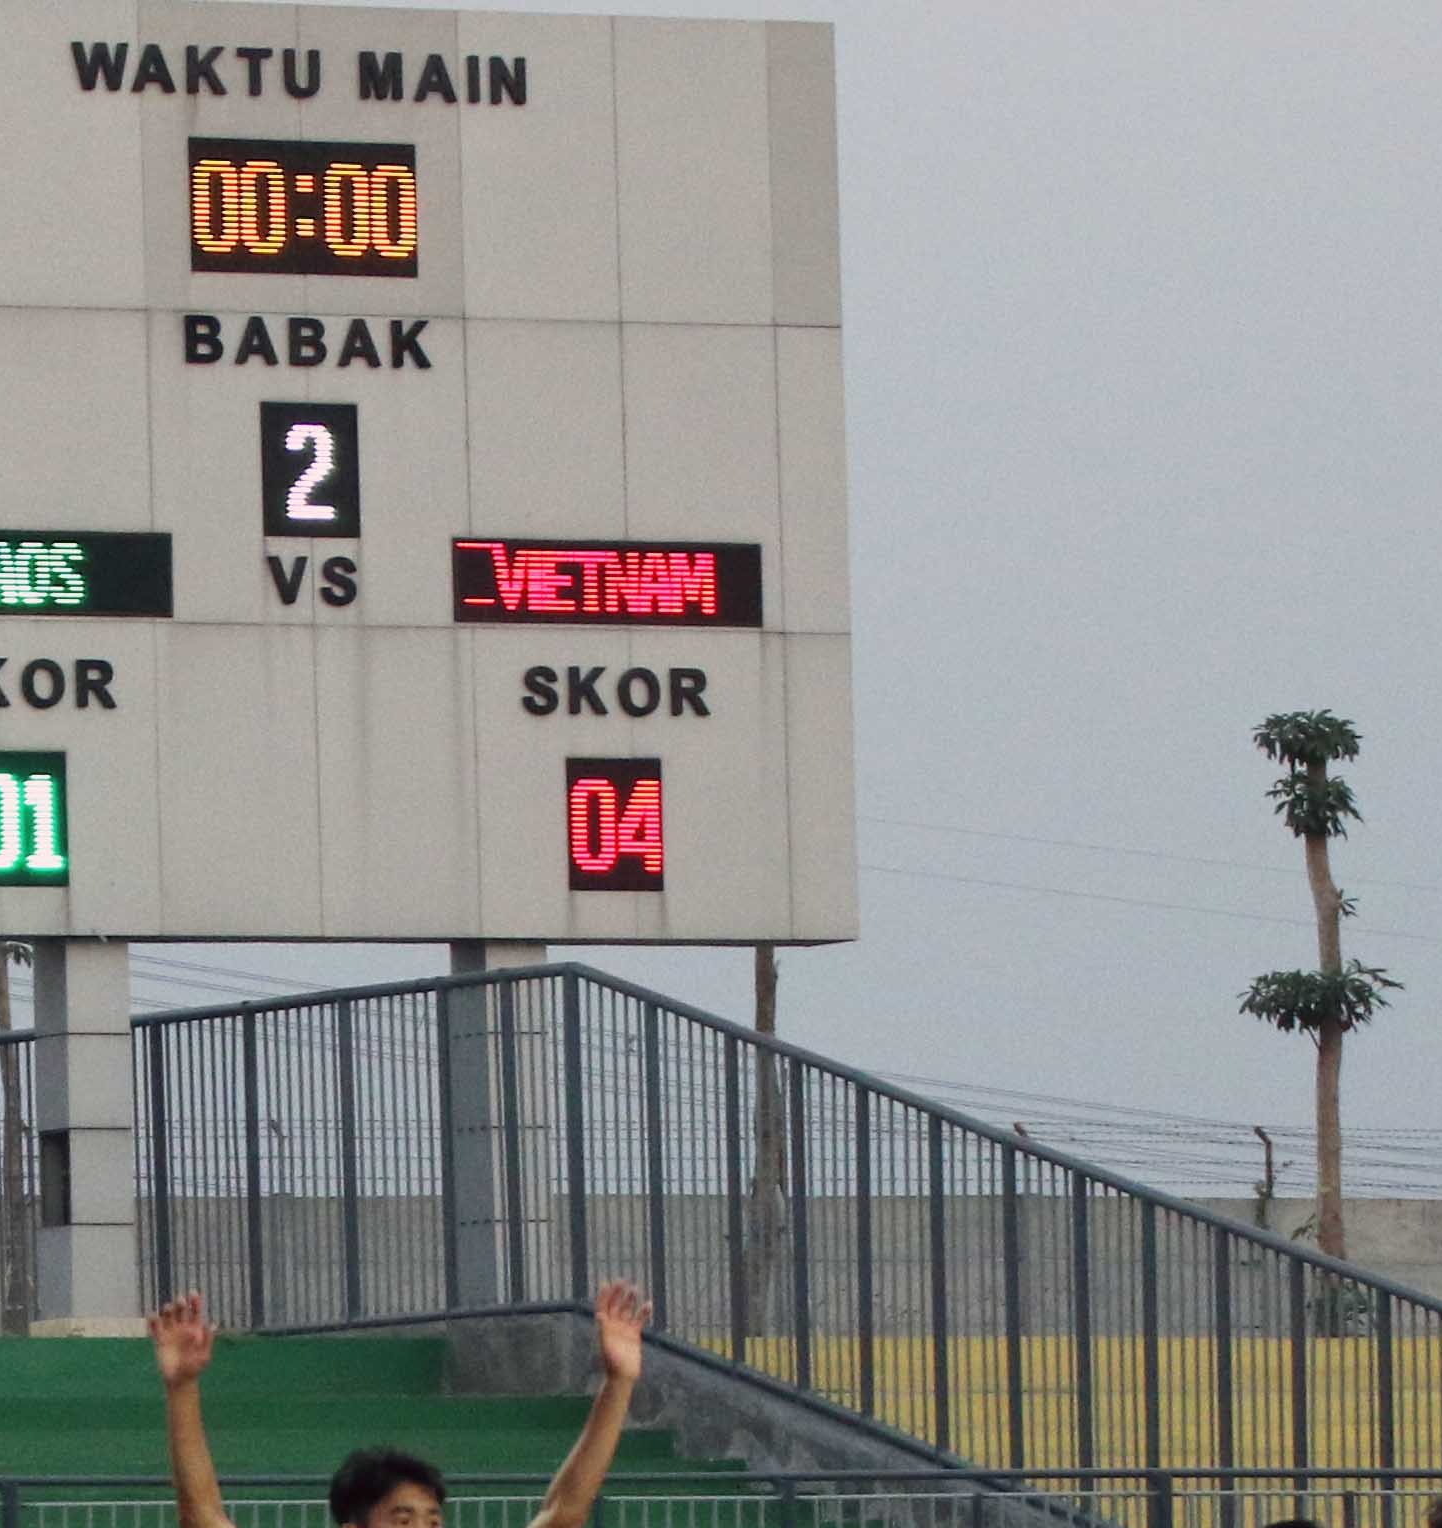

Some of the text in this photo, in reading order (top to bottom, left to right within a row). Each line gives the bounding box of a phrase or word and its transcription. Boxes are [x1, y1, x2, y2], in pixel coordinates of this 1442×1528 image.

[71, 41, 528, 105] WAKTU MAIN
[191, 159, 416, 258] 00:00
[183, 314, 432, 369] BABAK
[285, 424, 337, 520] 2
[266, 556, 358, 606] VS
[491, 543, 717, 615] VIETNAM
[522, 665, 711, 718] SKOR
[569, 779, 662, 871] 04
